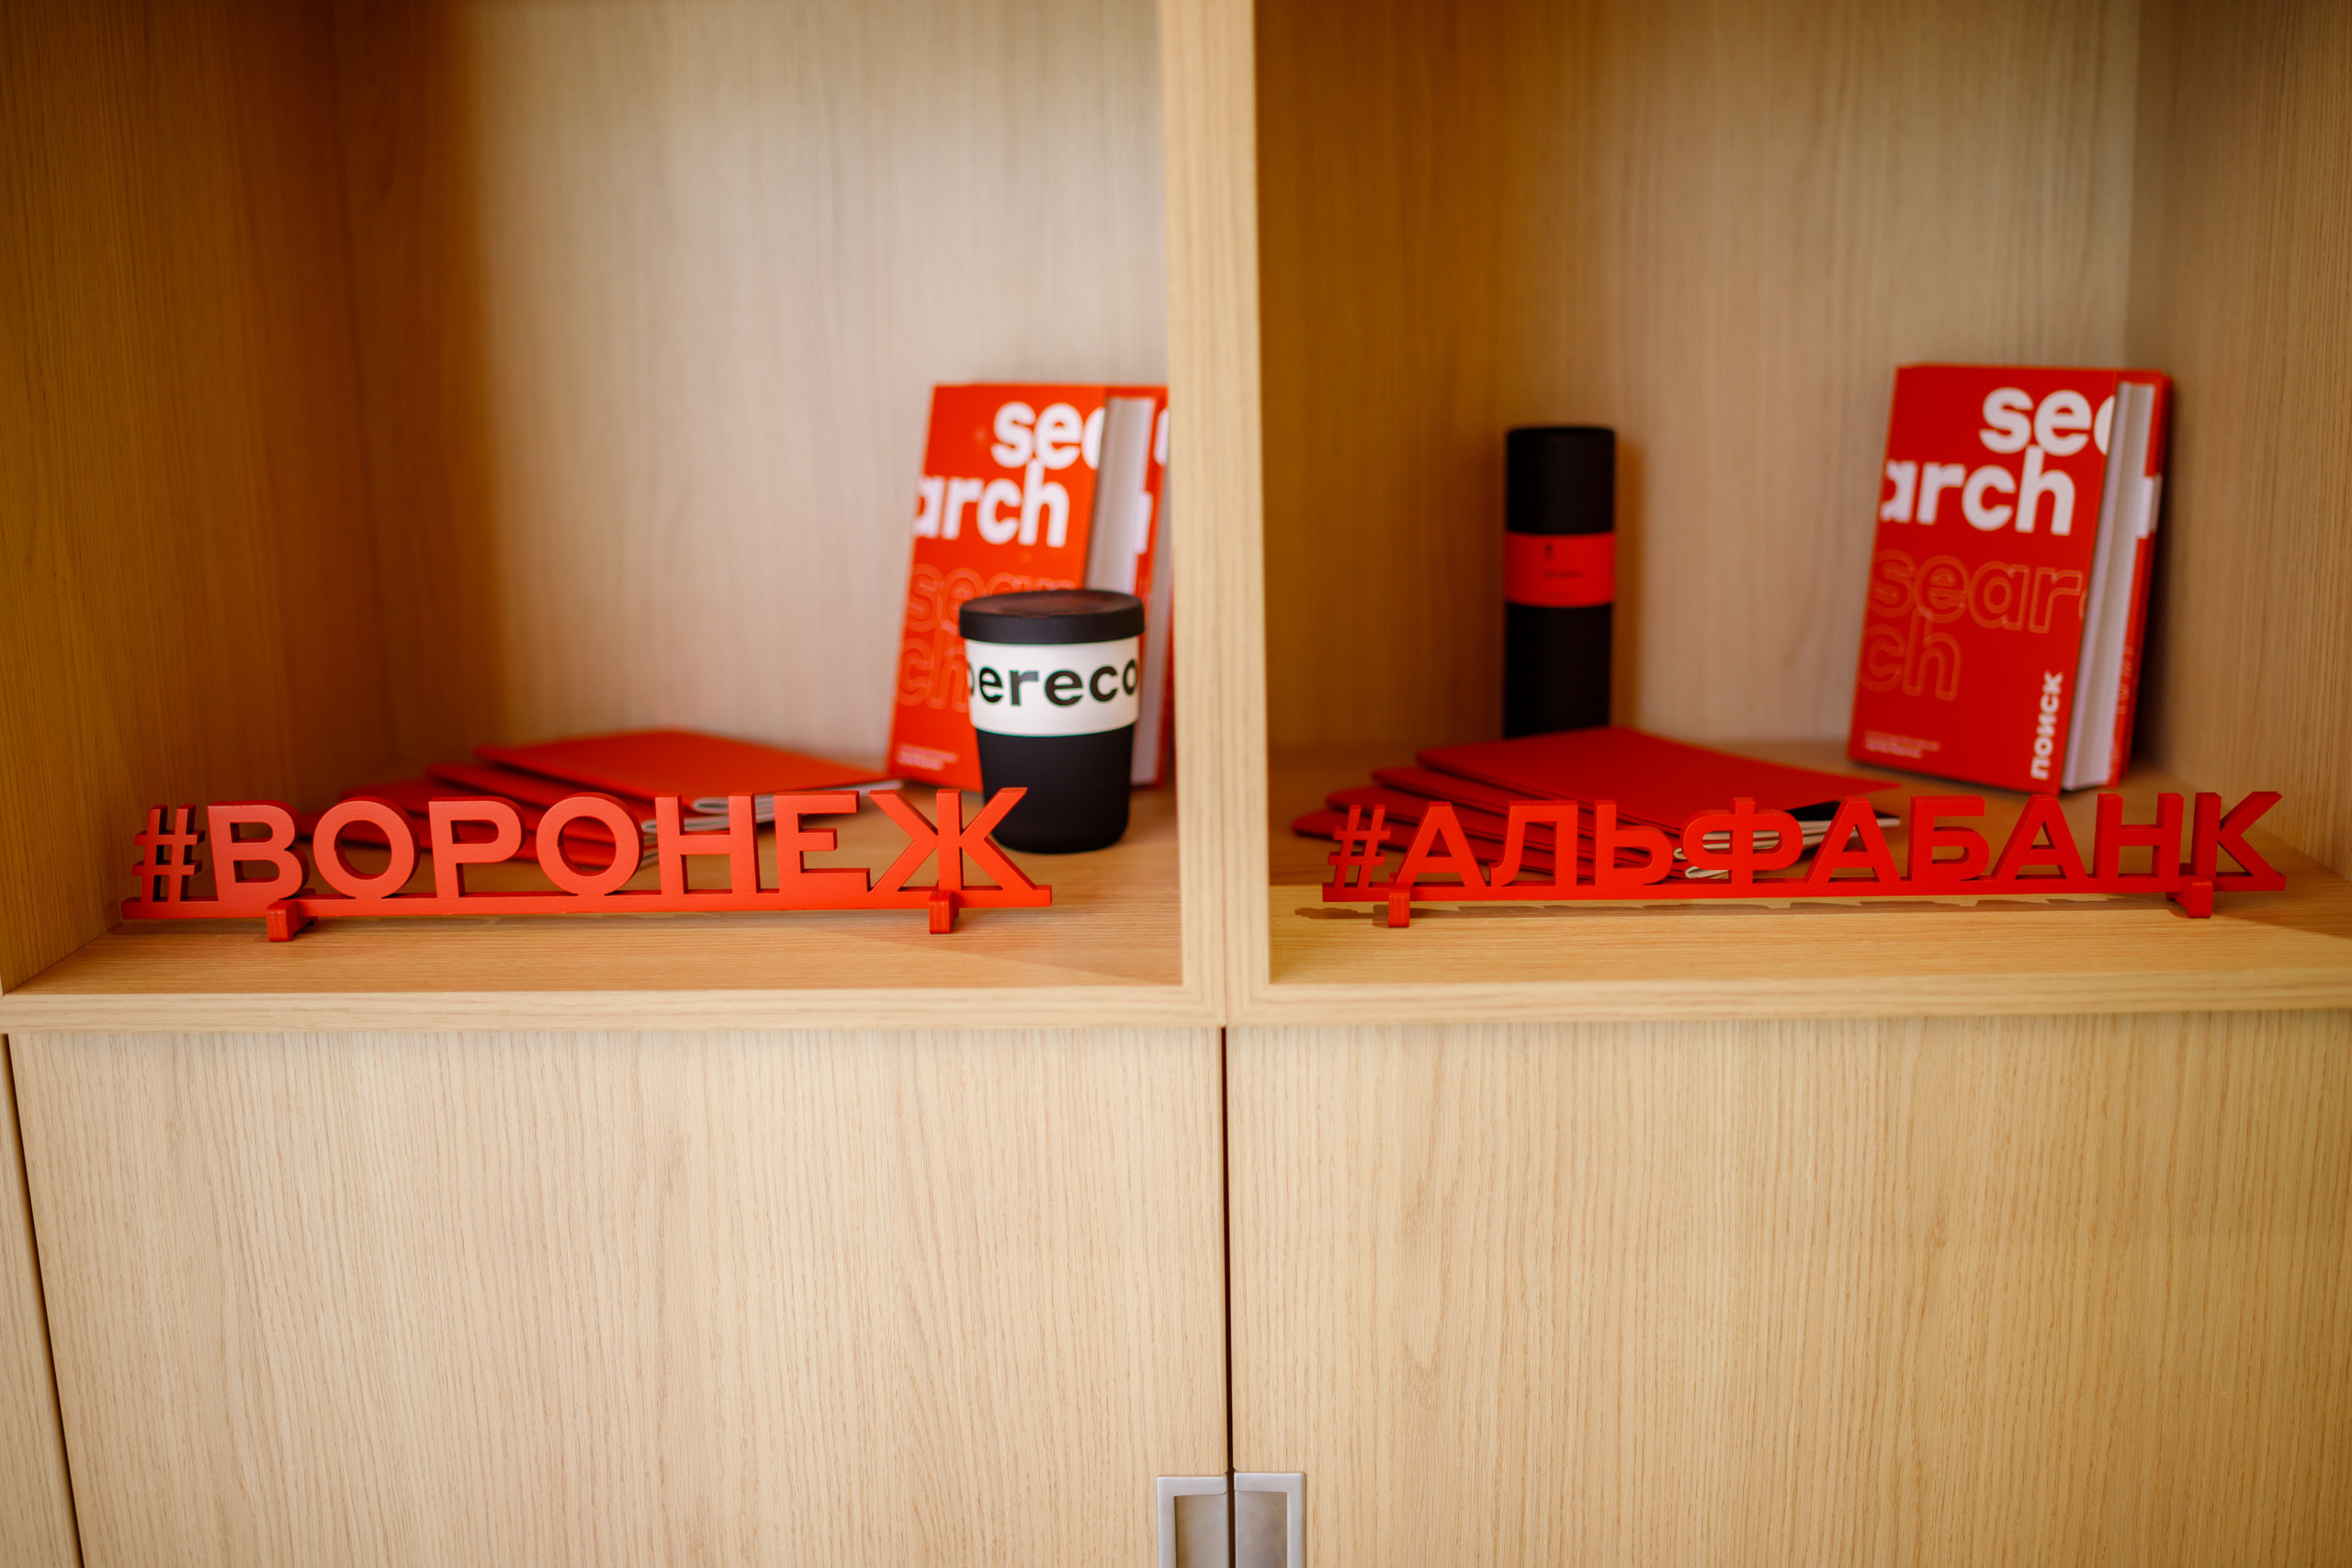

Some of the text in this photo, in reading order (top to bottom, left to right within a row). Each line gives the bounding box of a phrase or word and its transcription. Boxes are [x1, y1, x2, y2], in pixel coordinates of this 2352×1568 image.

[1868, 548, 2087, 634] sear
[967, 659, 1138, 707] ereco
[1858, 614, 1962, 701] ch
[130, 786, 1037, 904] #ВОРОНЕЖ
[1326, 791, 2285, 891] #АЛЬФАБАНК
